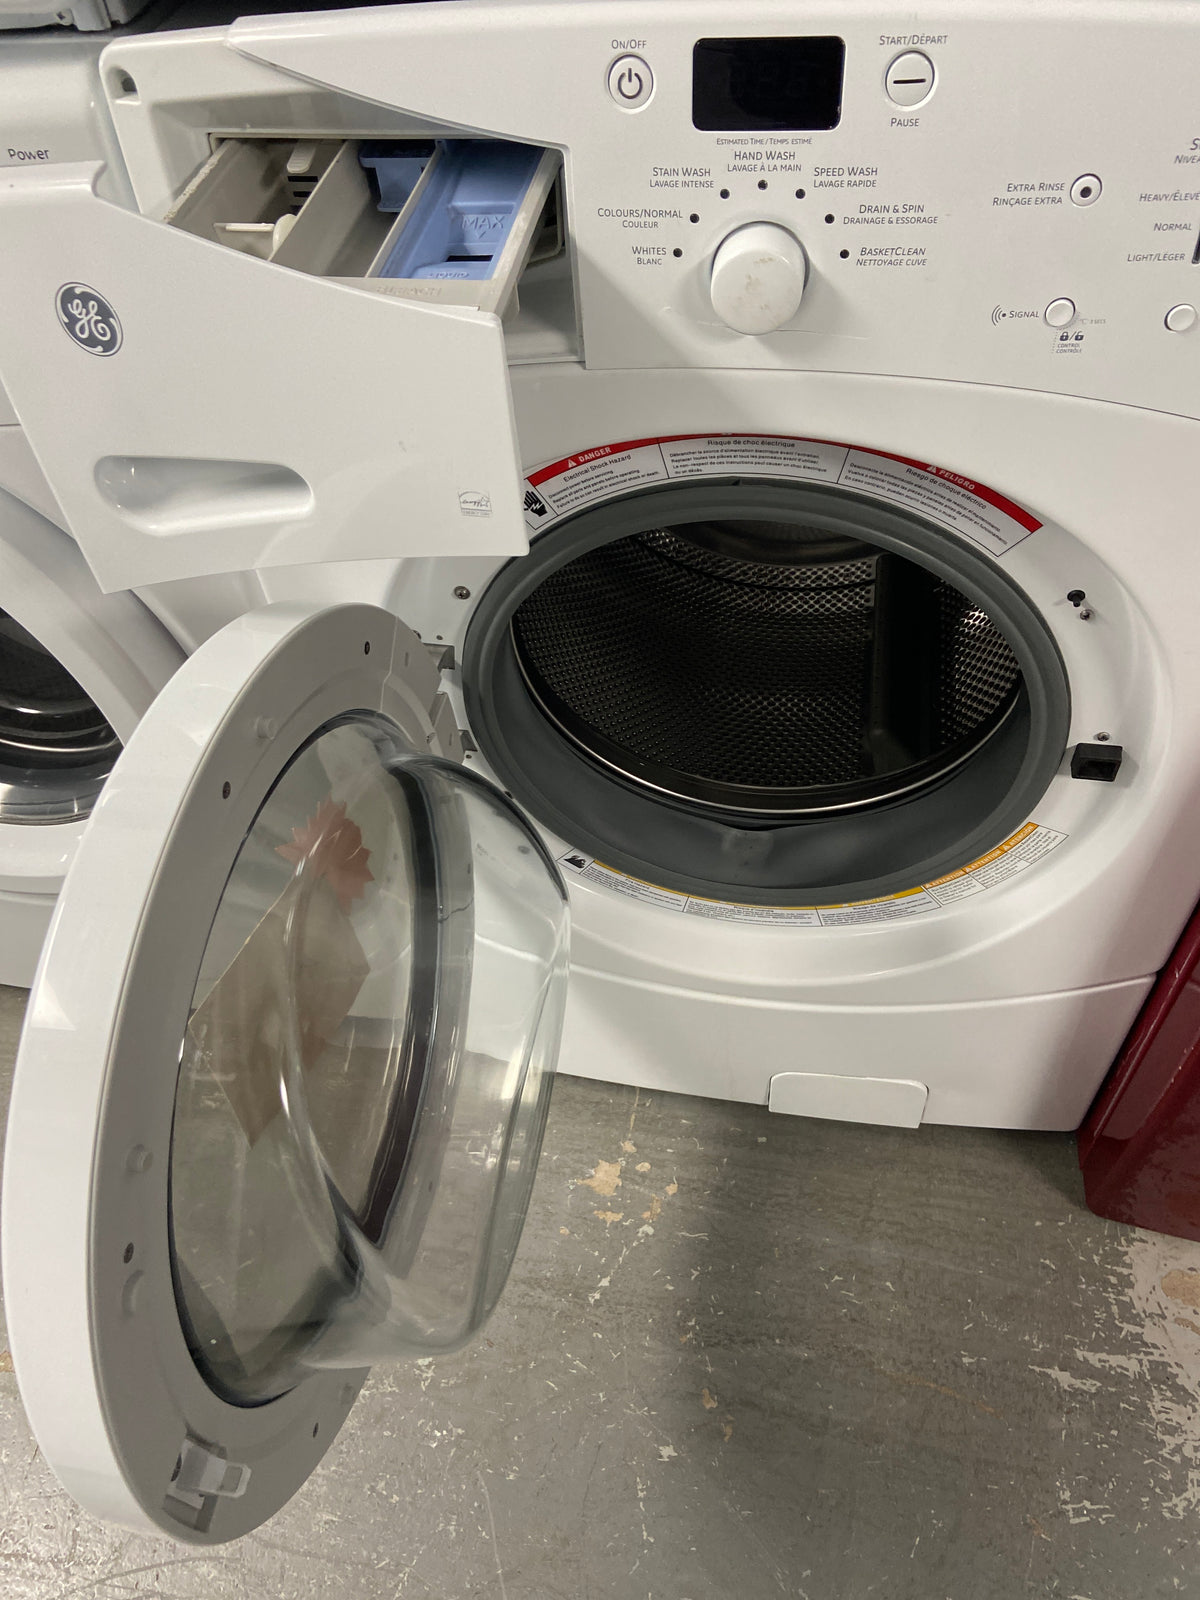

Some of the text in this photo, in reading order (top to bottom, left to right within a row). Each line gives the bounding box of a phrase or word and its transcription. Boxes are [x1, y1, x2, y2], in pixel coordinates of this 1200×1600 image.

[612, 39, 646, 49] ON/OFF
[879, 33, 948, 46] START/DÉPART
[891, 118, 919, 127] PAUSE
[8, 148, 49, 161] Power
[735, 151, 795, 160] HAND WASH
[653, 167, 710, 177] STAIN WASH
[728, 164, 757, 172] LAVAGE
[768, 164, 778, 172] LA
[814, 167, 877, 176] SPEED WASH
[650, 179, 679, 187] LAVAGE
[814, 180, 844, 188] LAVAGE
[1007, 183, 1065, 192] EXTRA RINSE
[993, 197, 1062, 207] RINÇAGE EXTRA
[598, 208, 683, 218] COLOURS/NORMAL
[859, 204, 924, 213] DRAIN & SPIN
[462, 215, 504, 229] MAX
[622, 220, 658, 228] COULEUR
[1154, 223, 1192, 231] NORMAL
[632, 246, 666, 255] WHITES
[637, 257, 662, 265] BLANC
[856, 258, 904, 267] NETTOYAGE
[1008, 310, 1040, 319] SIGNAL
[761, 440, 795, 448] électrique
[578, 446, 612, 462] DANGER
[563, 454, 631, 482] Electrical Shock Hazard
[939, 469, 975, 490] PELIGRO
[906, 467, 928, 480] Riesgo
[938, 482, 961, 495] choque
[961, 493, 986, 509] eléctrico
